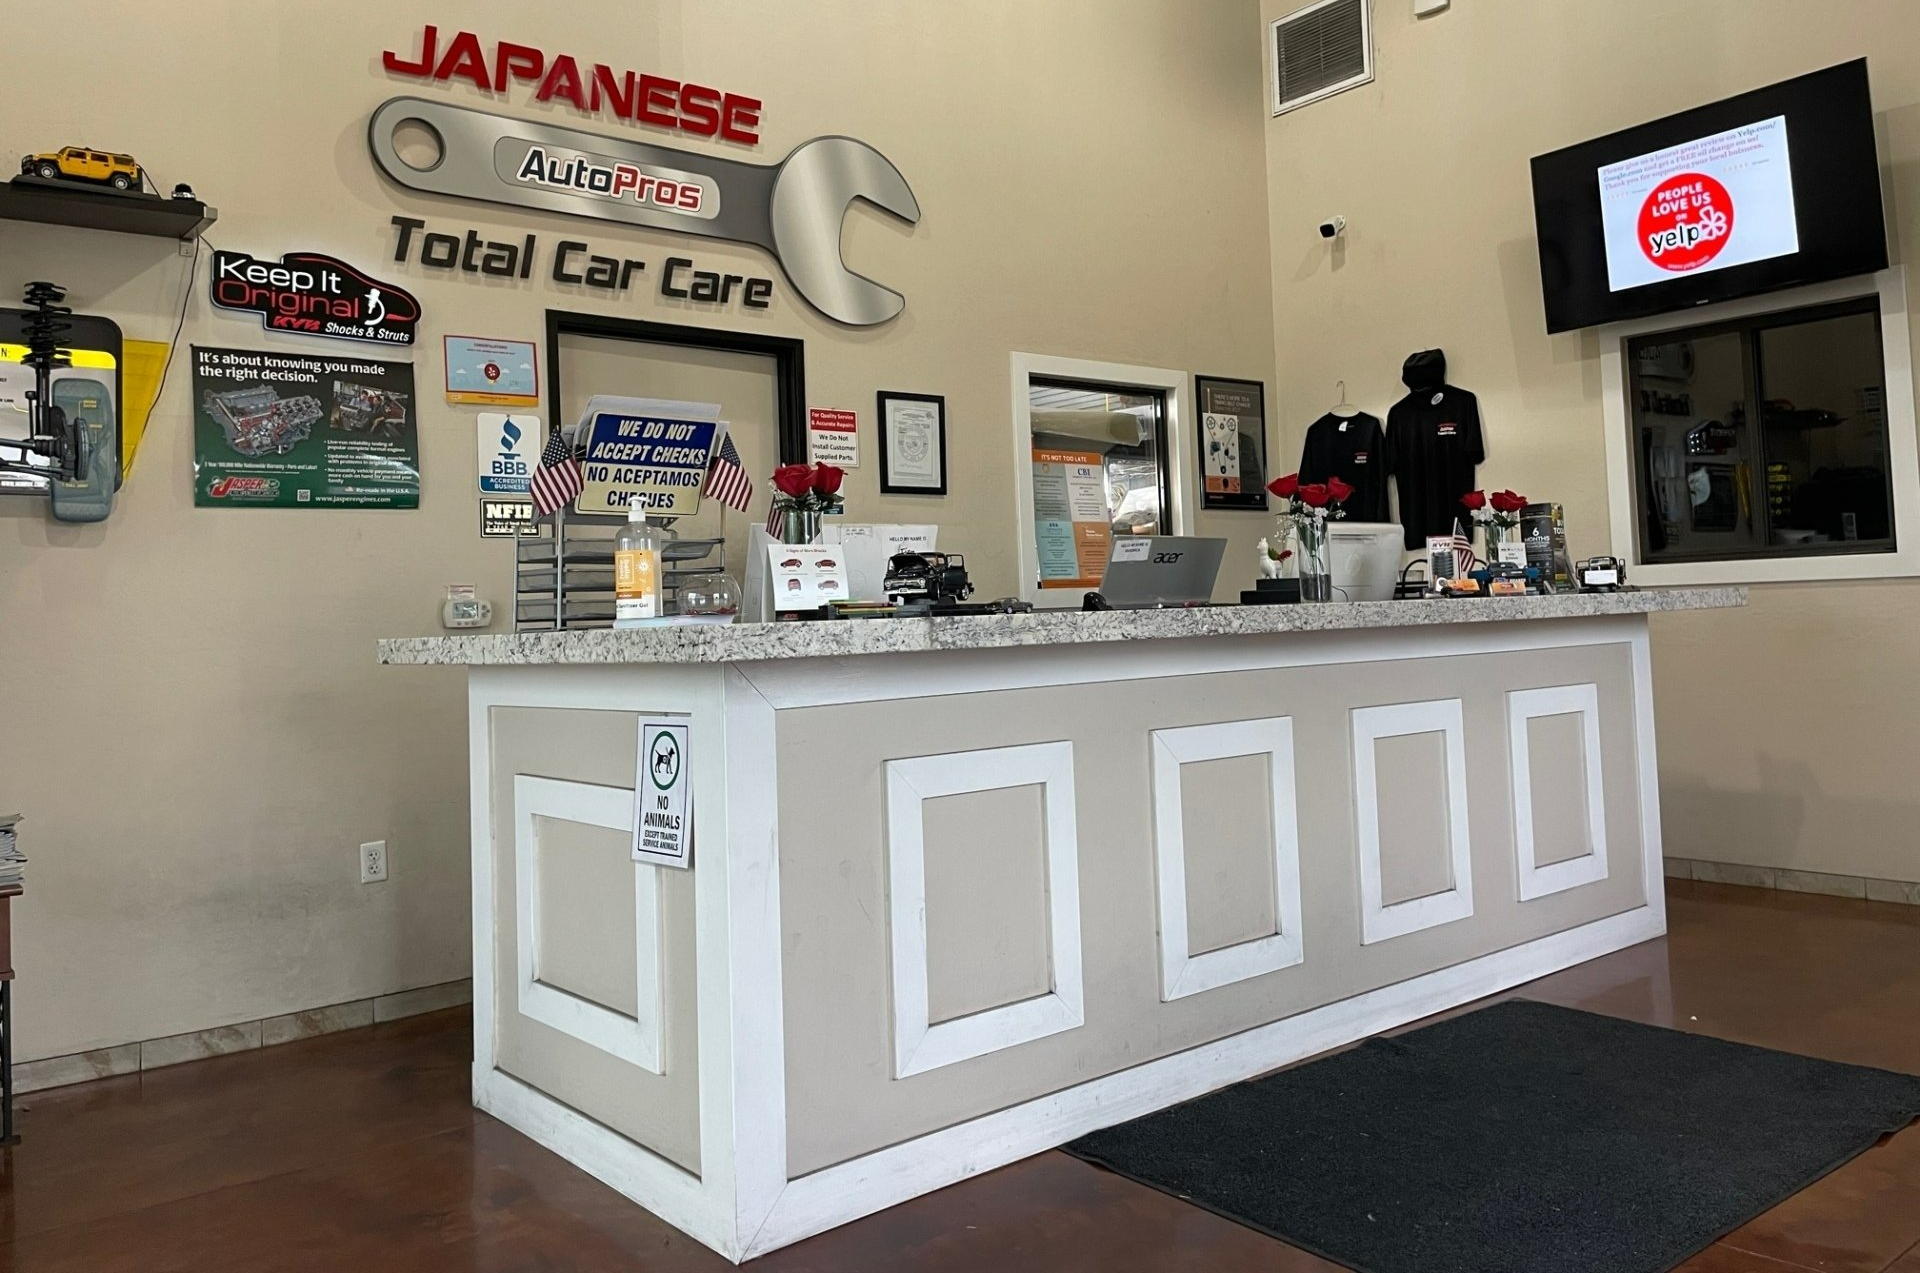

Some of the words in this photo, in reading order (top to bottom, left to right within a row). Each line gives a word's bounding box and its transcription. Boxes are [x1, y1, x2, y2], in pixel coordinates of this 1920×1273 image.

[382, 24, 762, 145] JAPANESE
[1700, 138, 1725, 149] review
[1737, 121, 1777, 137] Yelp.com/
[1676, 152, 1697, 163] FREE
[1698, 149, 1707, 158] oil
[1709, 143, 1734, 155] change
[1650, 161, 1690, 178] supporting
[1691, 158, 1709, 168] your
[1710, 152, 1728, 162] local
[518, 148, 702, 210] AutoPros
[1657, 182, 1703, 202] PEOPLE
[1652, 198, 1688, 217] LOVE
[1692, 191, 1711, 207] US
[1675, 213, 1688, 221] ON
[1651, 225, 1699, 253] yelp
[391, 215, 536, 279] Total
[552, 240, 645, 291] Car
[661, 256, 773, 309] Care
[220, 256, 314, 293] Keep
[322, 270, 341, 294] It
[219, 280, 359, 319] Original
[325, 322, 364, 337] Shocks
[366, 327, 374, 338] &
[377, 327, 410, 342] Struts
[199, 352, 219, 363] It's
[222, 353, 261, 366] about
[264, 356, 321, 372] knowing
[324, 362, 347, 374] you
[350, 364, 385, 375] made
[199, 365, 222, 377] the
[226, 366, 258, 381] right
[261, 370, 318, 383] decision.
[618, 420, 642, 437] WE
[642, 422, 664, 438] DO
[665, 423, 696, 441] NOT
[591, 442, 652, 461] ACCEPT
[652, 445, 706, 464] CHECKS
[587, 466, 608, 482] NO
[612, 468, 700, 487] ACEPTAMOS
[1077, 468, 1091, 476] CBI
[211, 477, 264, 497] JASPER
[1532, 527, 1539, 536] 6
[1153, 552, 1183, 564] acer
[657, 795, 669, 810] NO
[644, 812, 680, 830] ANIMALS
[643, 838, 659, 848] SERVICE
[659, 841, 678, 851] ANIMALS
[645, 830, 660, 839] EXCEPT
[660, 832, 677, 841] TRAINED
